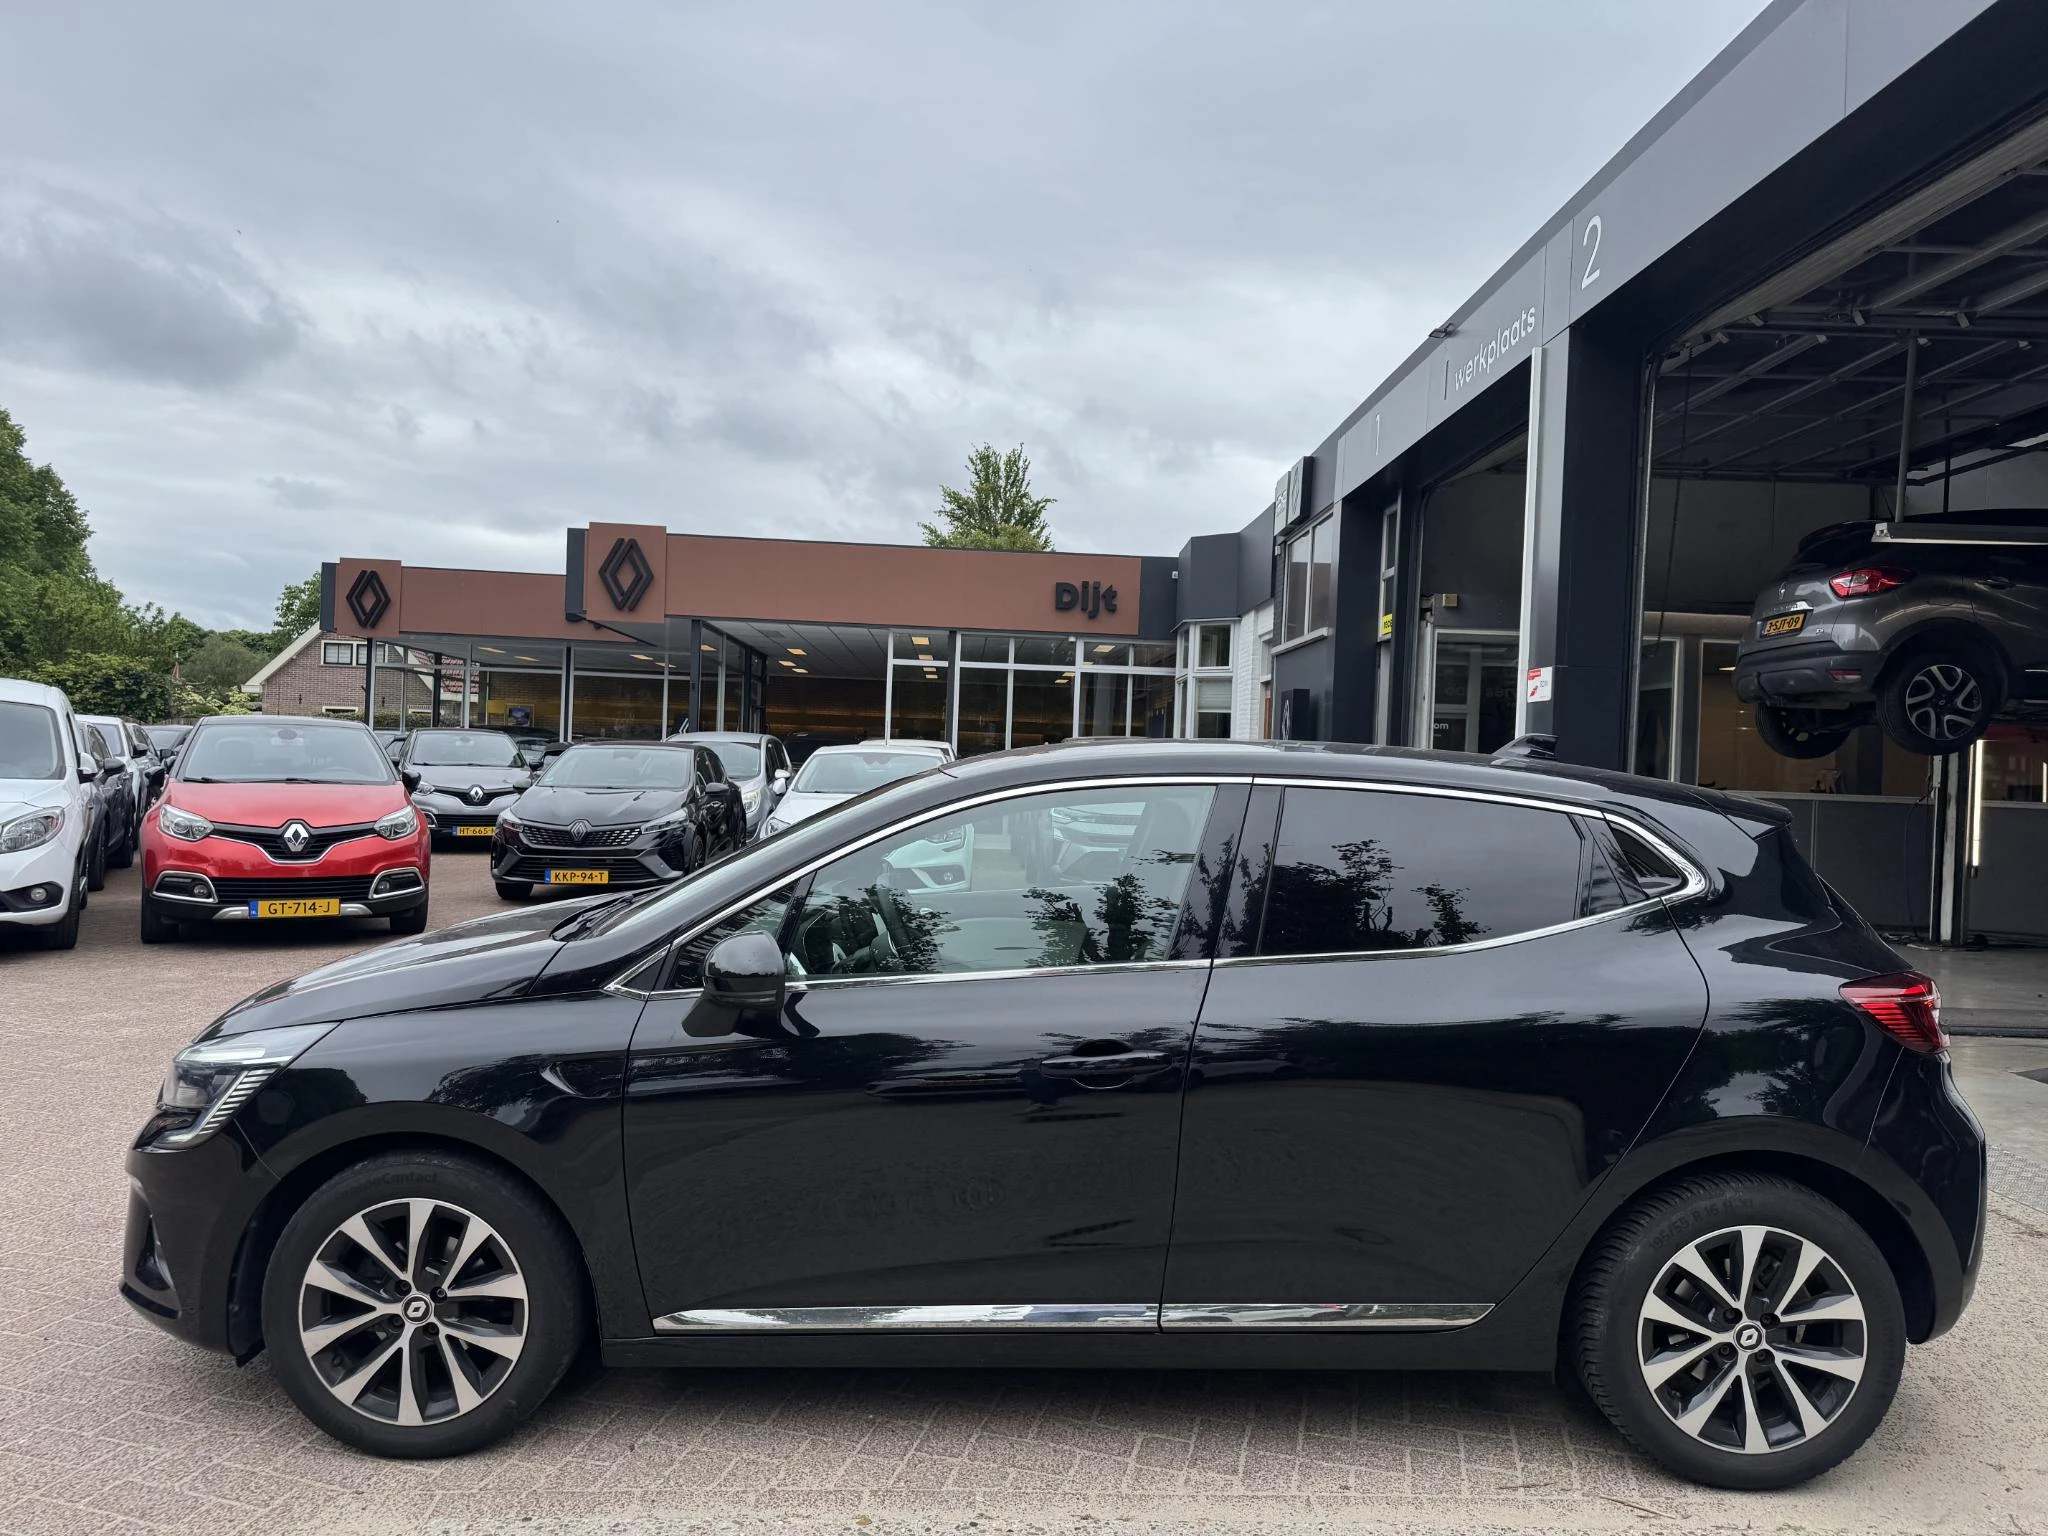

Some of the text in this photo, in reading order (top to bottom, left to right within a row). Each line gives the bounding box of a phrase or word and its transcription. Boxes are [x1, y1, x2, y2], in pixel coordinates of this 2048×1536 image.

[1581, 215, 1602, 290] 2
[1454, 306, 1536, 391] werkplaats
[1375, 414, 1381, 456] 1
[1056, 581, 1118, 620] Dijt
[554, 871, 605, 882] KKP-94-T
[267, 901, 331, 915] GT-714-J
